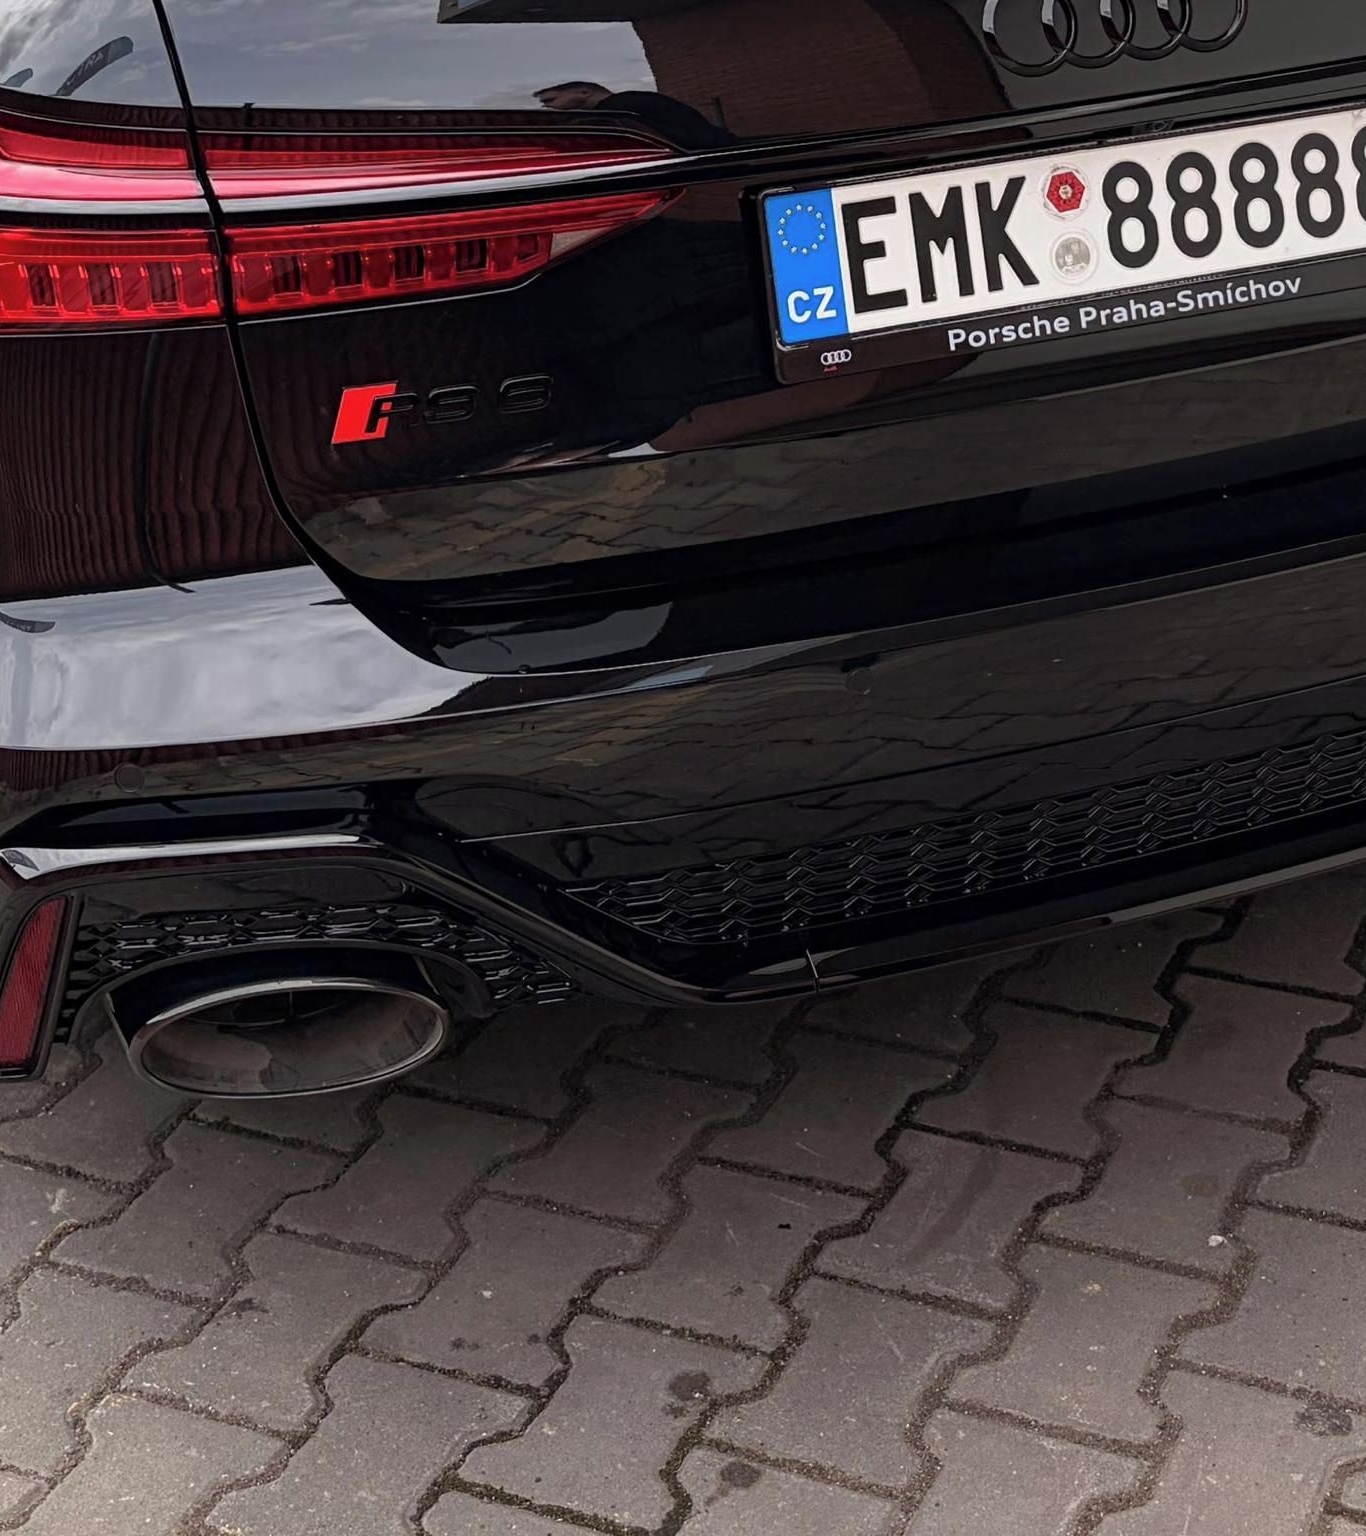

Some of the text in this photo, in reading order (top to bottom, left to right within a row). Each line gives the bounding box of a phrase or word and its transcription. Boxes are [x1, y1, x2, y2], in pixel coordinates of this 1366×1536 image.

[840, 175, 1037, 315] EMK
[787, 284, 838, 325] CZ
[947, 273, 1303, 352] Porsche Praha-Smíchov
